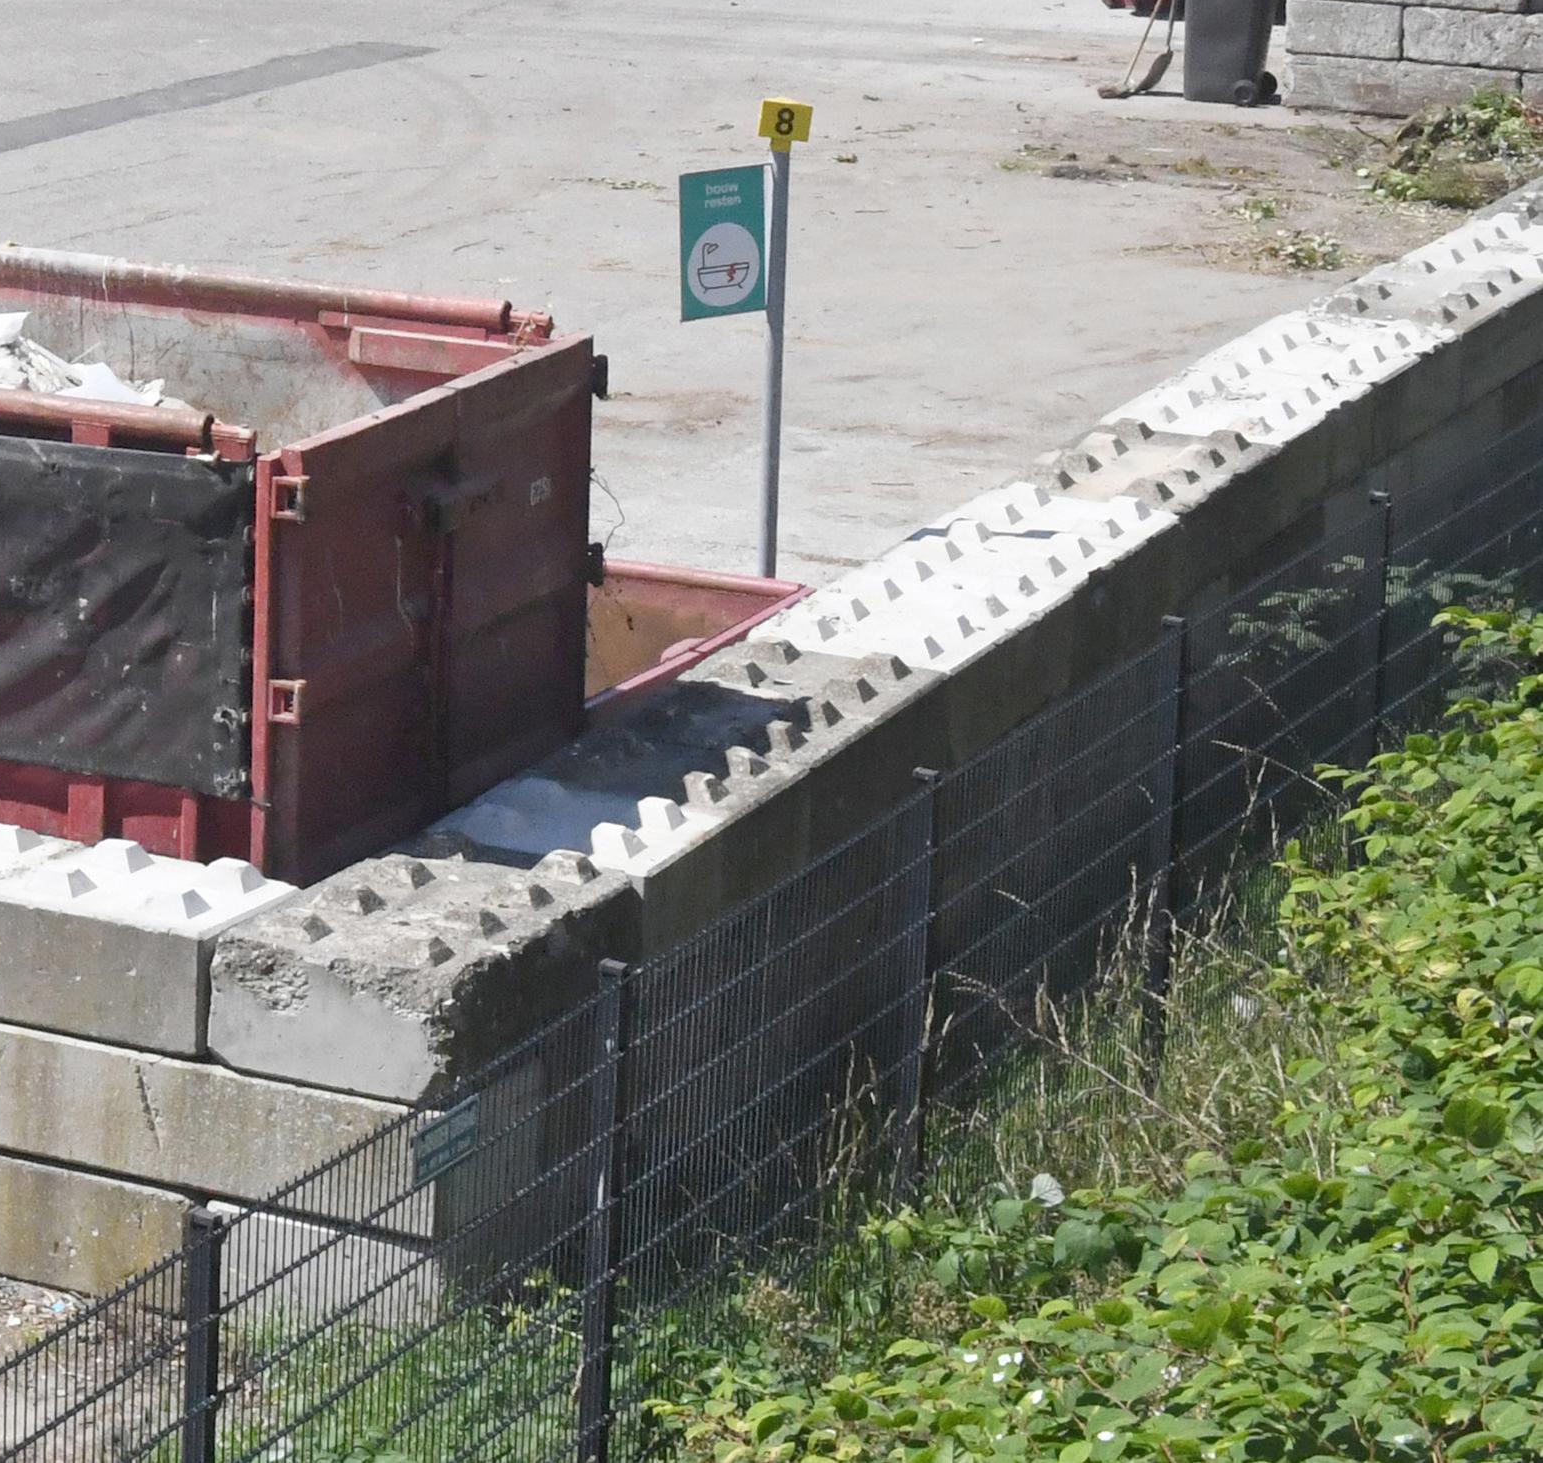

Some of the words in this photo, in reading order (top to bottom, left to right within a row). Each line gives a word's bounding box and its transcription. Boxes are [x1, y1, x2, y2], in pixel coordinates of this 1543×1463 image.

[775, 107, 795, 136] 8
[705, 183, 740, 195] bouw
[704, 194, 742, 209] resten
